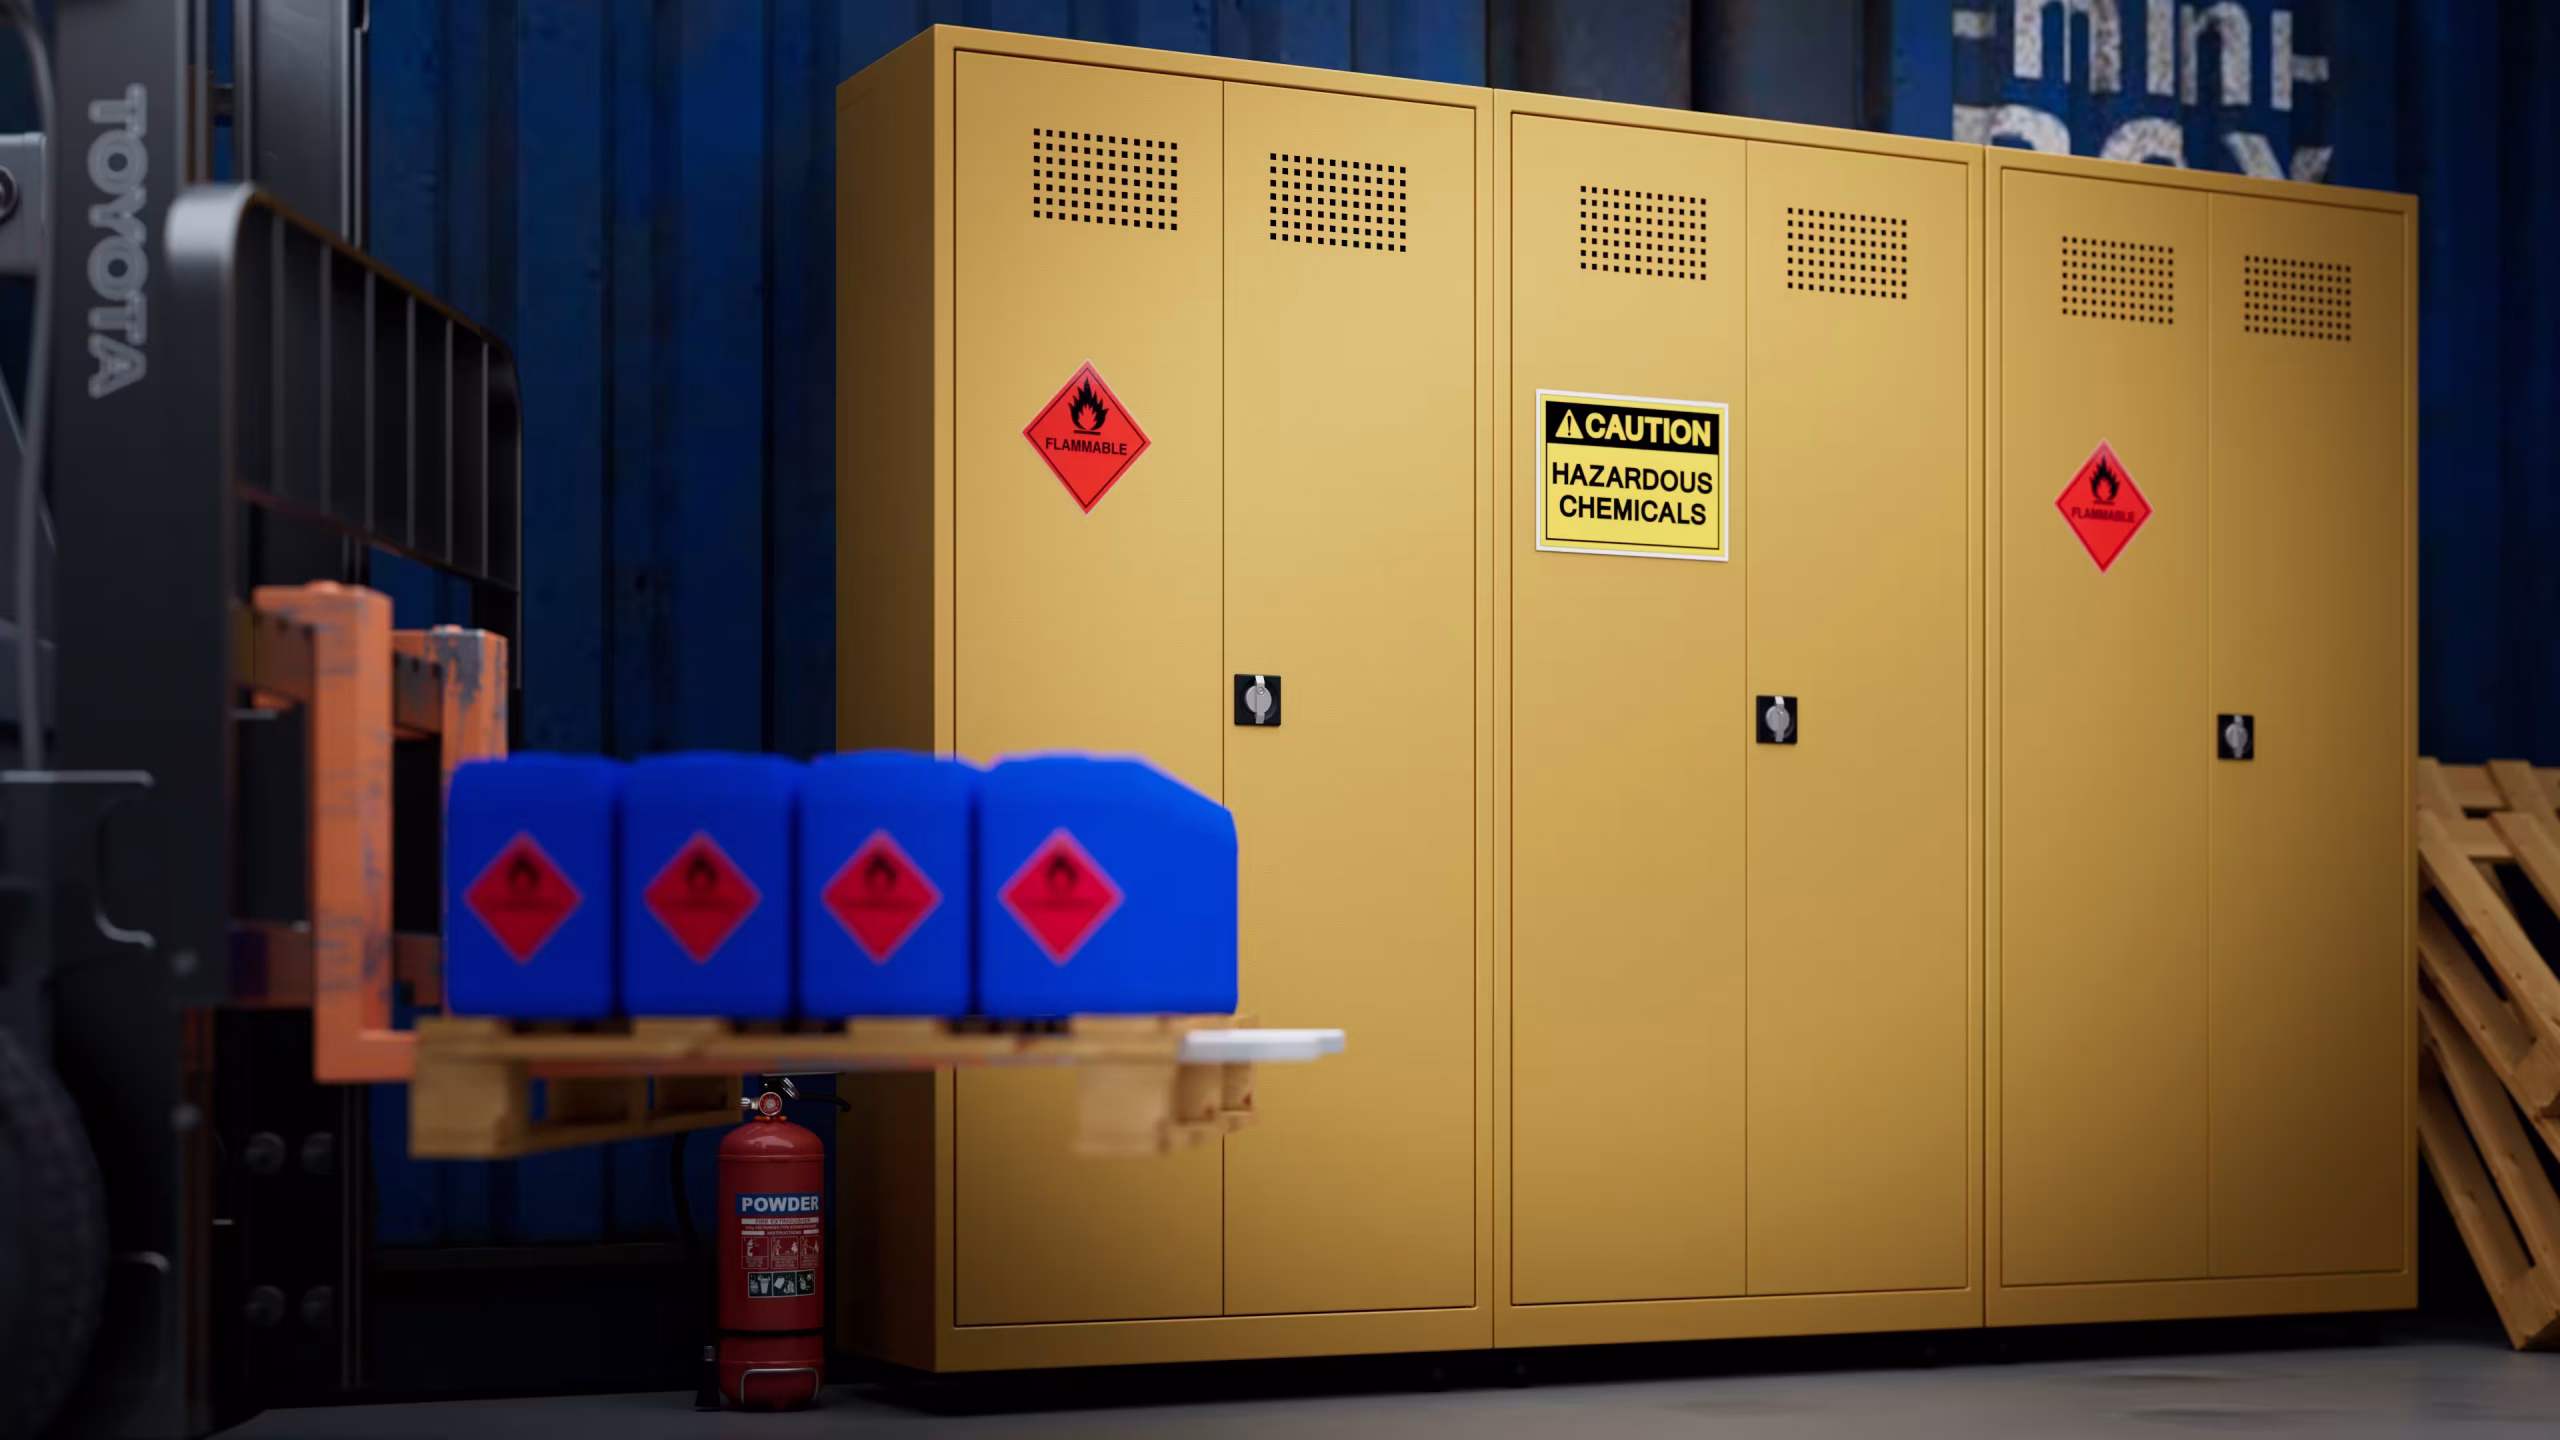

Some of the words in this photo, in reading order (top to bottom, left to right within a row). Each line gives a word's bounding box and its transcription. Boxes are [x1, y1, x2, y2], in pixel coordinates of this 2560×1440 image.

[87, 82, 148, 400] TOYOTA
[1585, 412, 1711, 447] CAUTION
[1045, 437, 1128, 456] FLAMMABLE
[1552, 462, 1713, 494] HAZARDOUS
[1559, 494, 1706, 525] CHEMICALS
[2071, 506, 2135, 523] FLAMMABLE
[741, 1195, 819, 1212] POWDER
